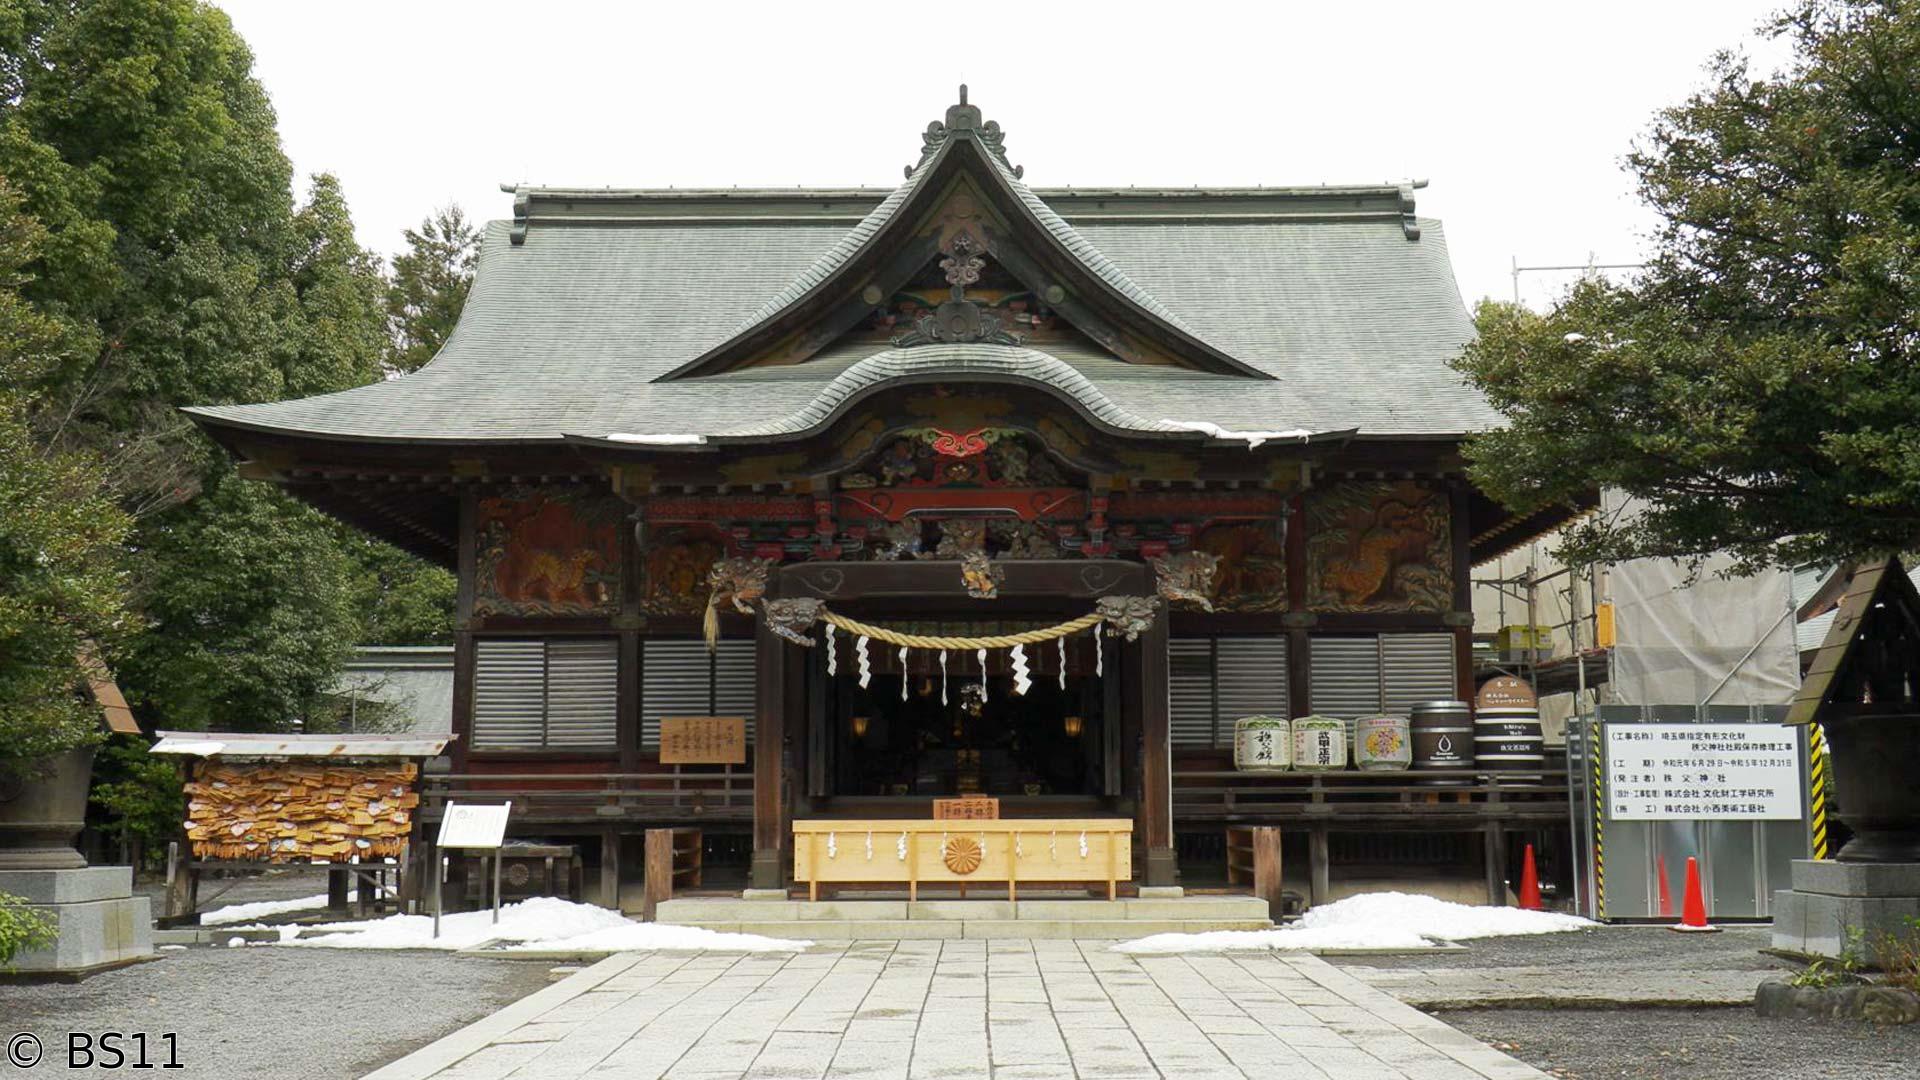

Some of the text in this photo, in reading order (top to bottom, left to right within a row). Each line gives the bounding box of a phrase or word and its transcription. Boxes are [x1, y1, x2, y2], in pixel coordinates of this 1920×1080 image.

[1661, 732, 1745, 741] 埼玉県指定有形文化財
[1318, 731, 1330, 765] 武甲正宗
[1664, 789, 1700, 798] 株式会社
[1703, 789, 1775, 798] 文化財工学研究所
[1664, 804, 1701, 813] 株式会社
